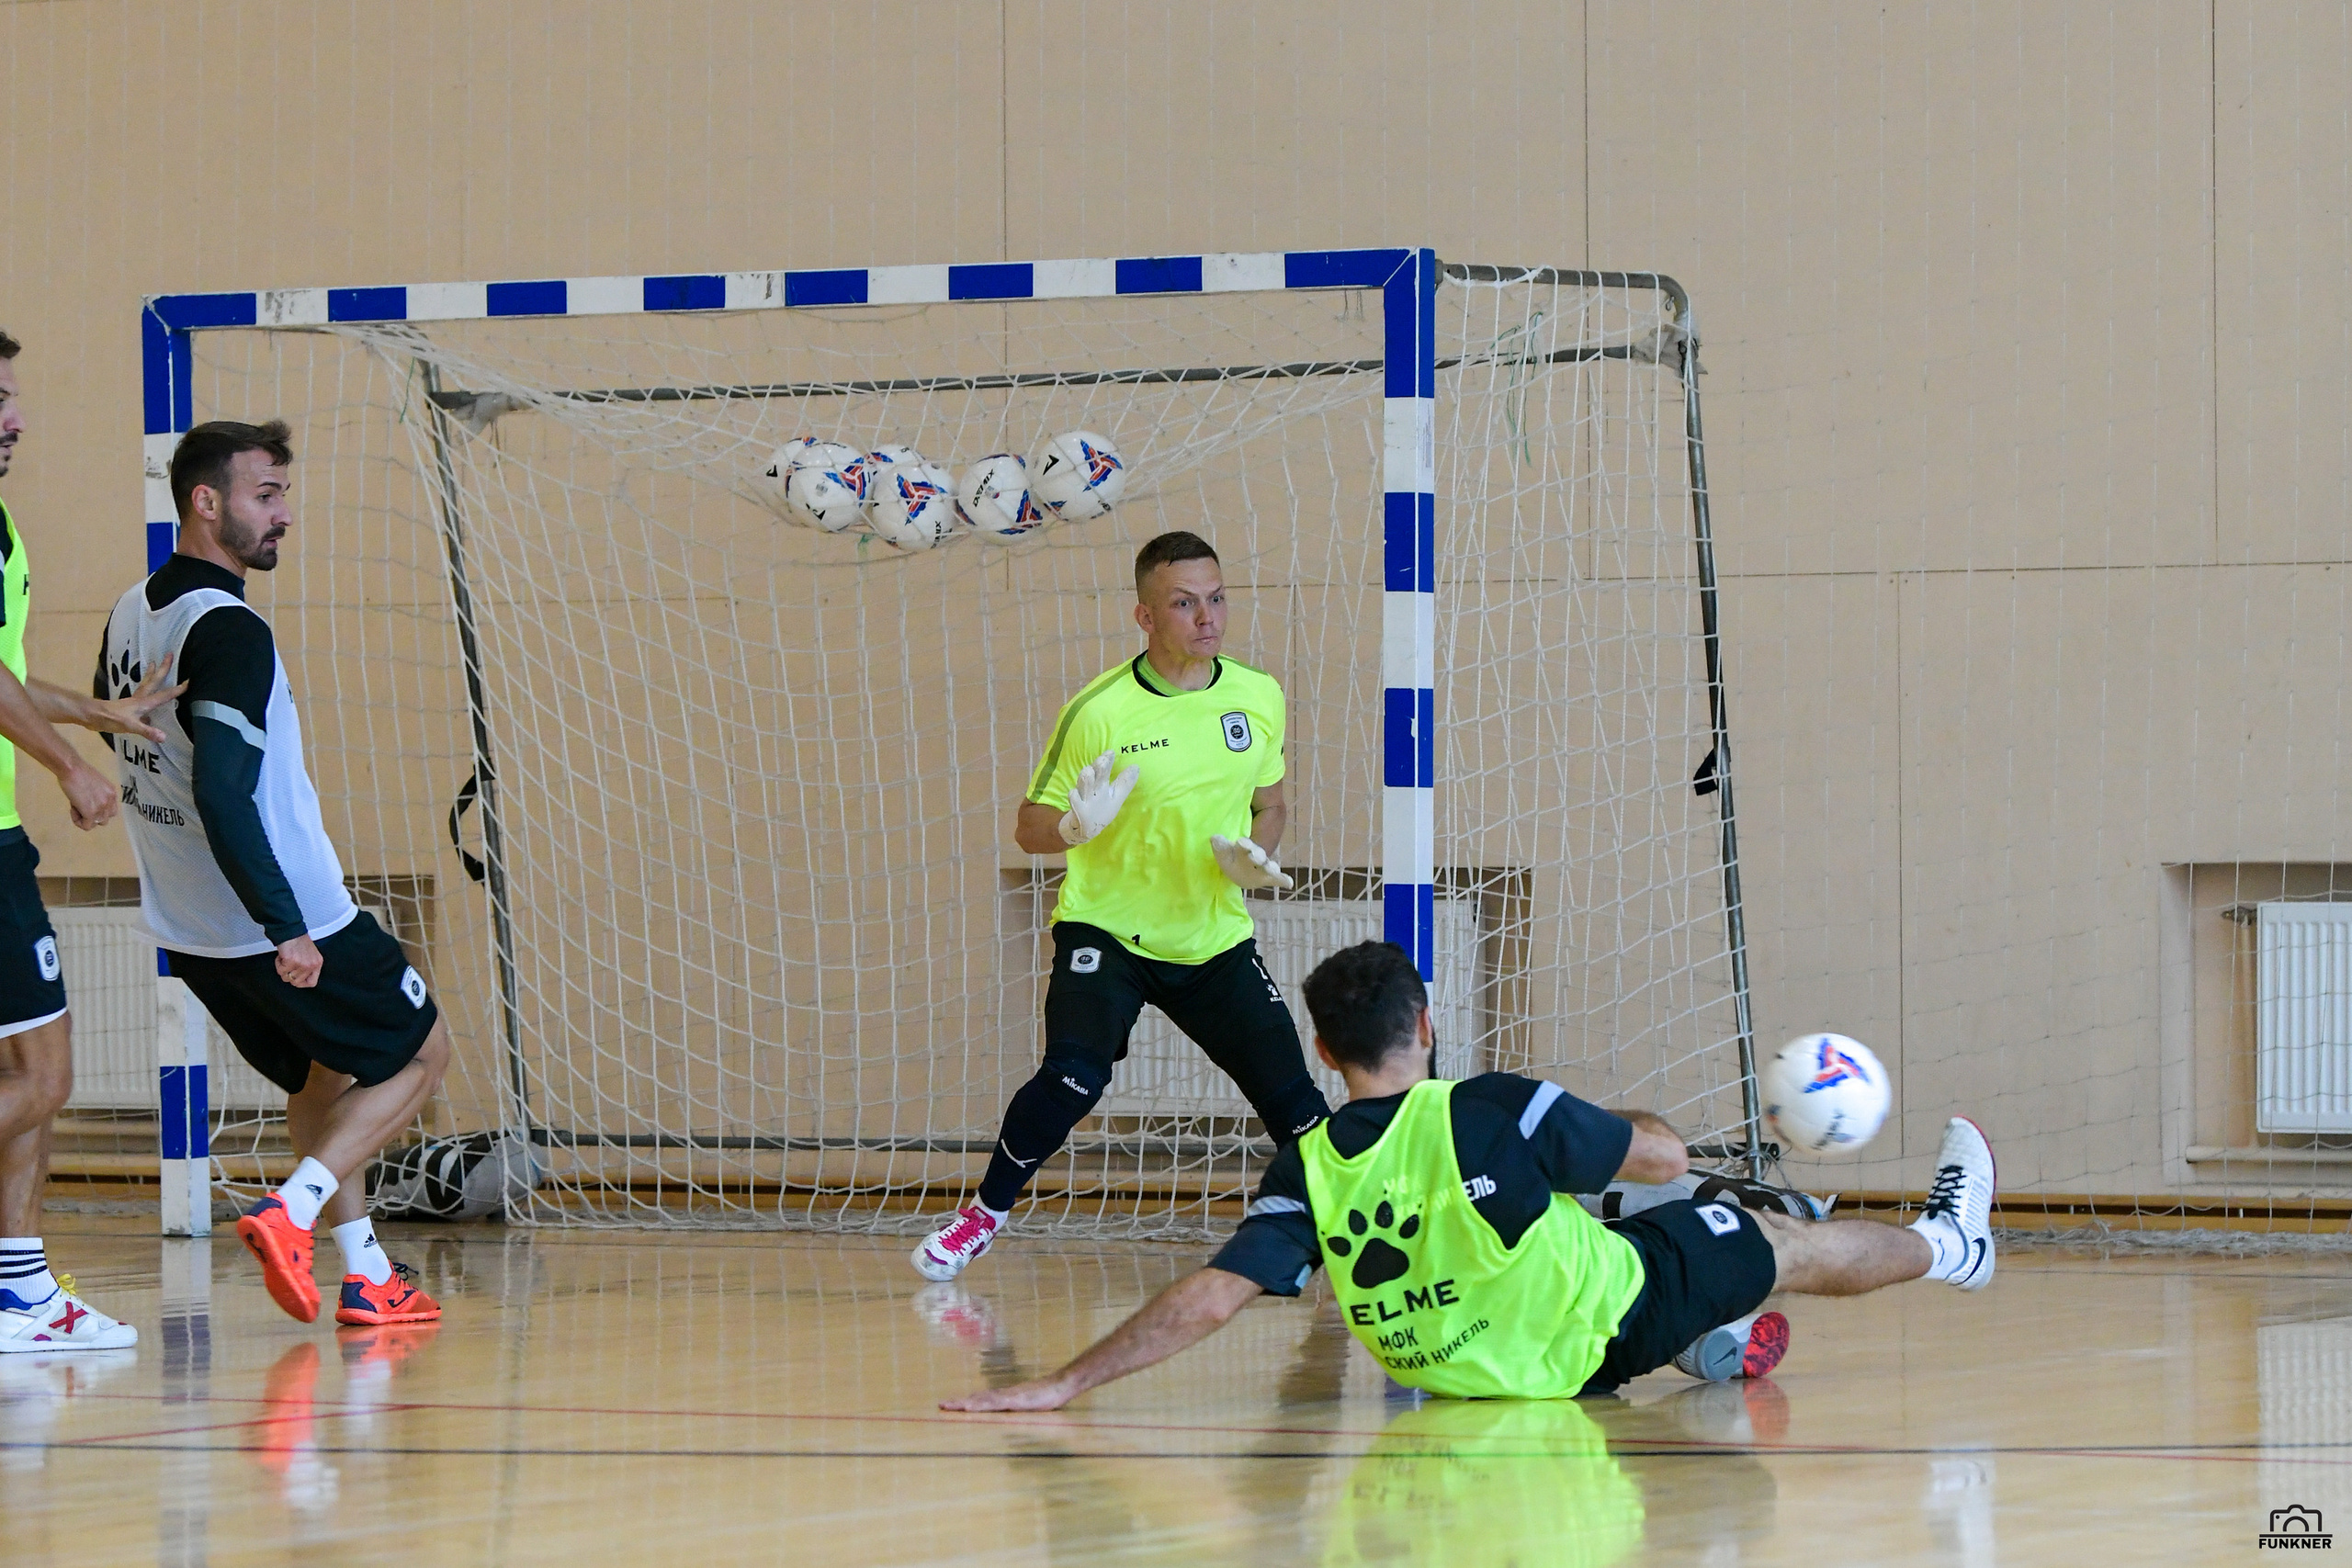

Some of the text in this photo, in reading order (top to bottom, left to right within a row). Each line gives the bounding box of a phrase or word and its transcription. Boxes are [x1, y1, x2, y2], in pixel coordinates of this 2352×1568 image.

[1121, 739, 1170, 754] KELME
[1378, 1326, 1419, 1351] МФК
[1430, 1318, 1489, 1364] НИКЕЛЬ
